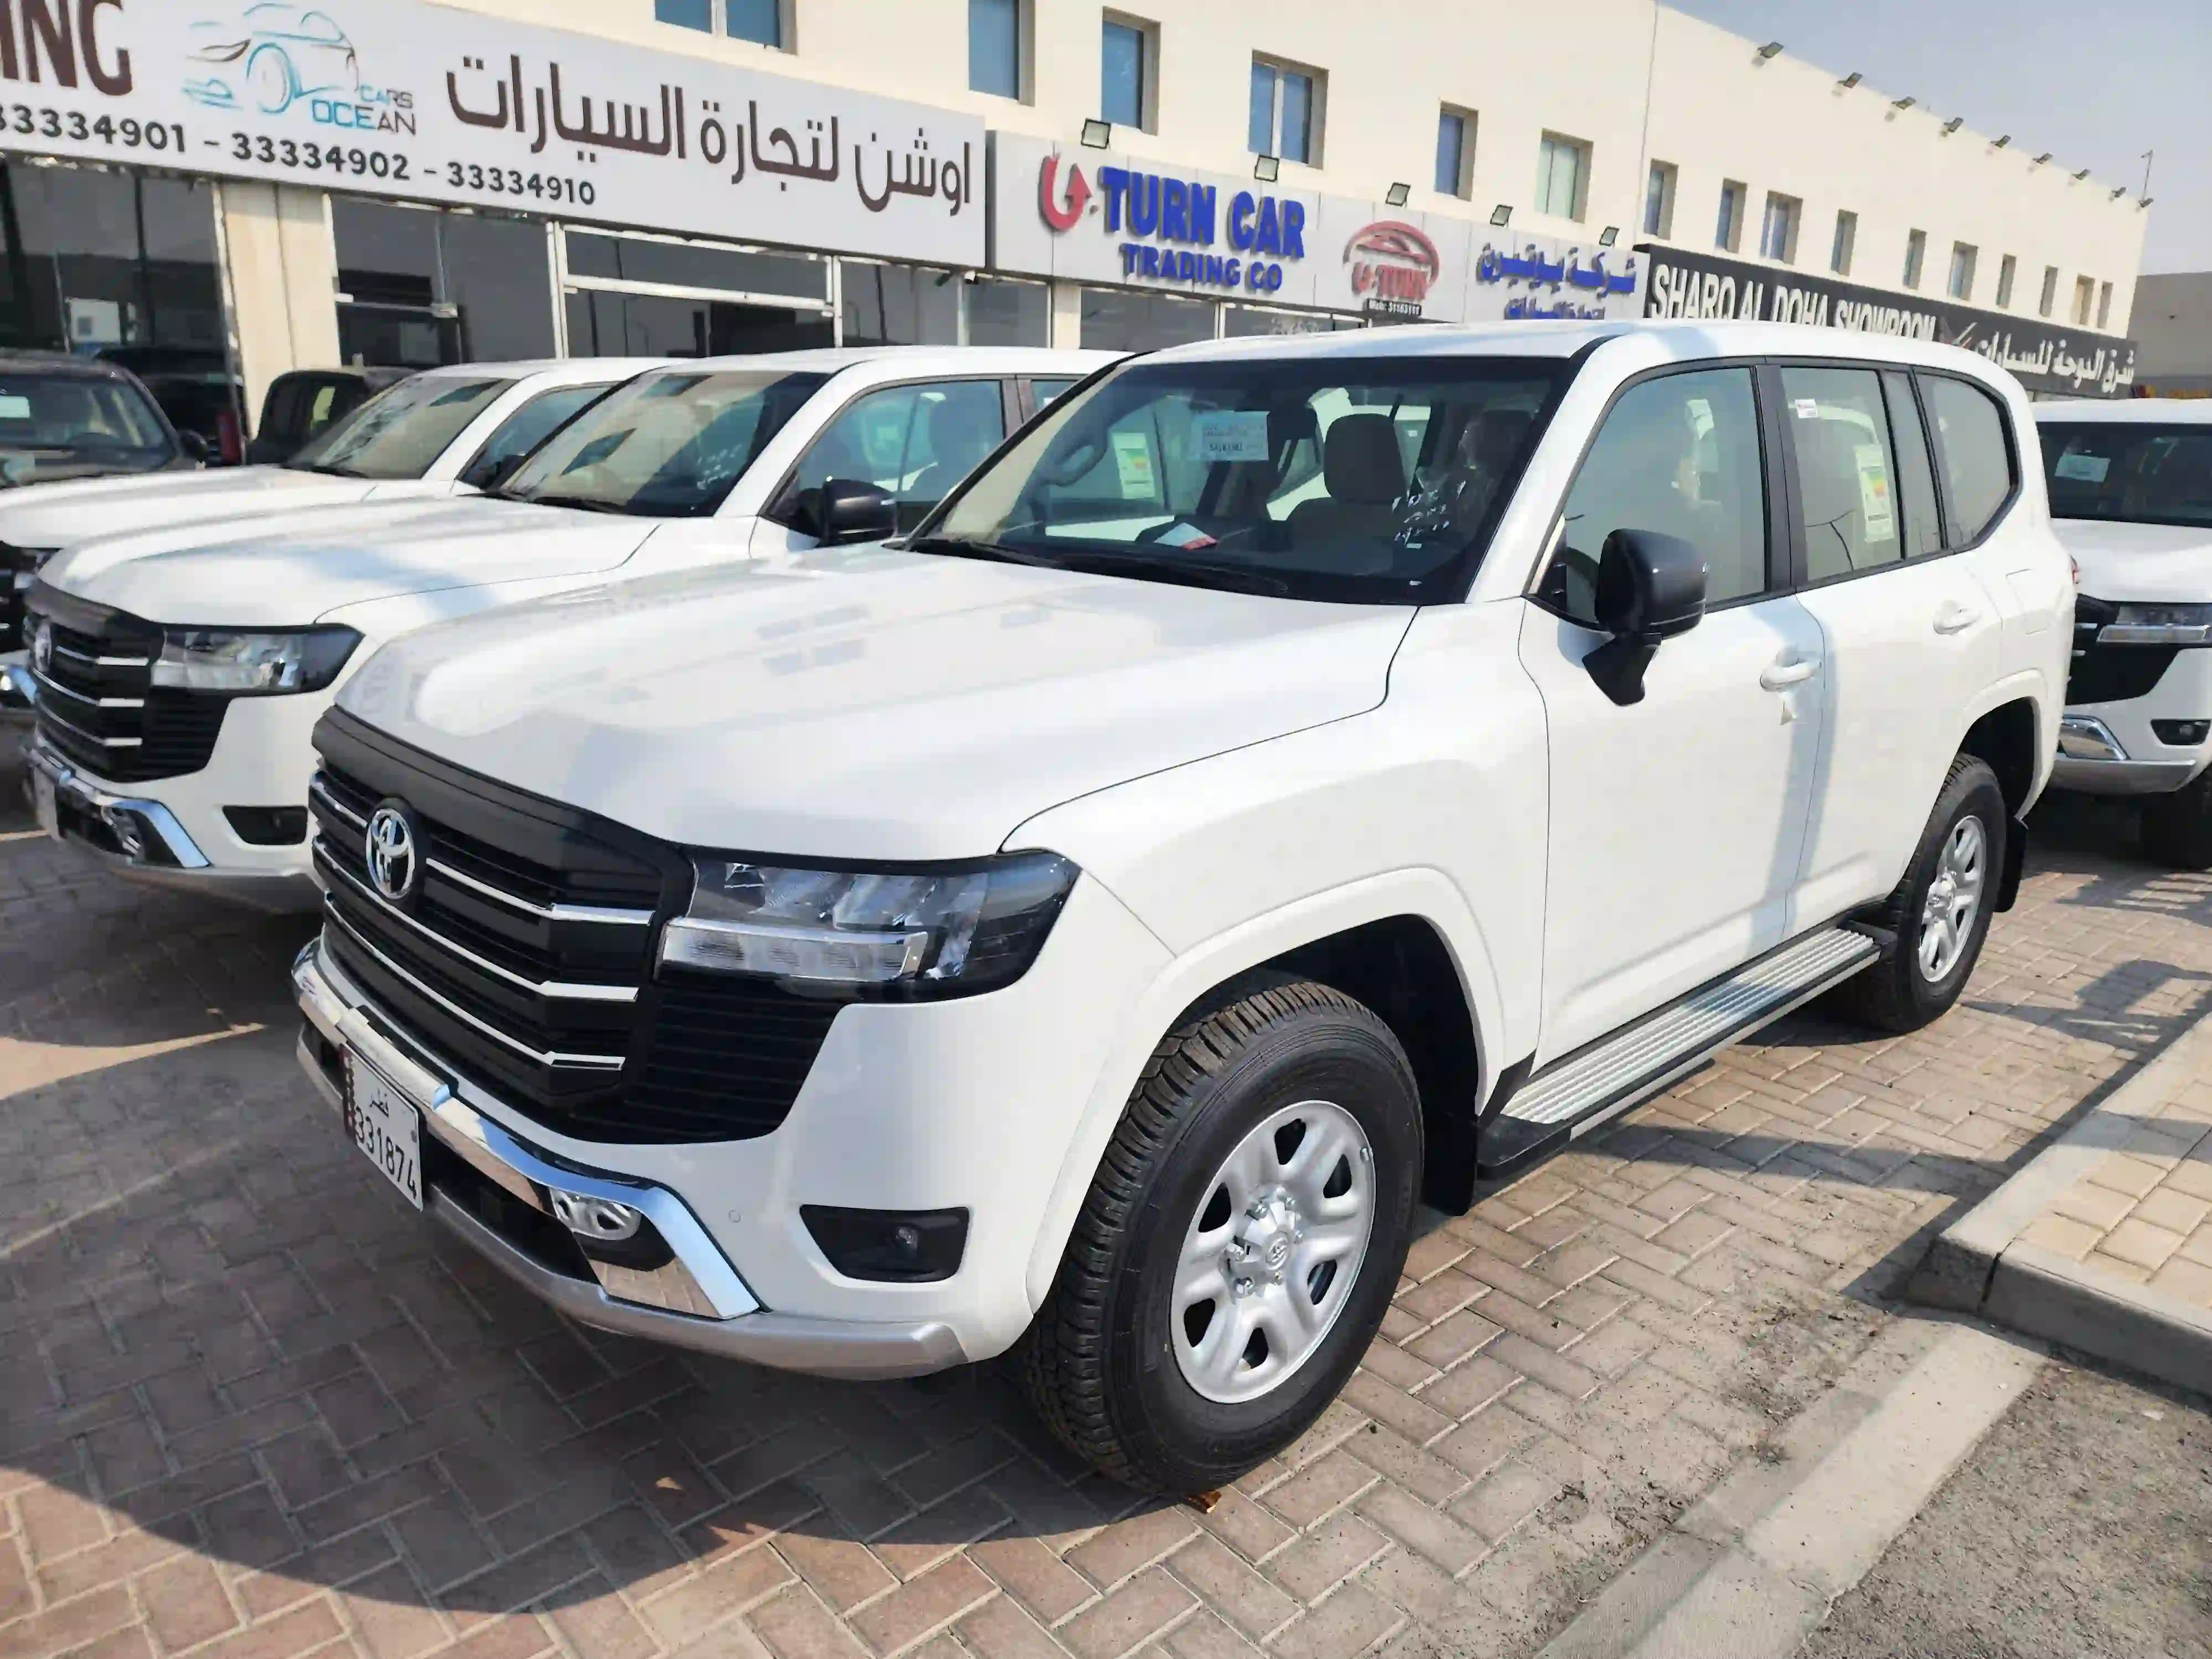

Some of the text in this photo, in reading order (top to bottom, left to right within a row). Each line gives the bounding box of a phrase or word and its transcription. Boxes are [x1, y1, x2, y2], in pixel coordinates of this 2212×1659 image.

[312, 99, 416, 136] OCEAN
[360, 84, 413, 109] CARS
[446, 54, 970, 216] اوشن لتجارة السيارات
[232, 132, 411, 180] 33334902
[447, 161, 596, 205] 33334910
[1227, 190, 1305, 260] CAR
[1120, 242, 1283, 291] TRADING CO
[1771, 285, 1828, 327] DOHA
